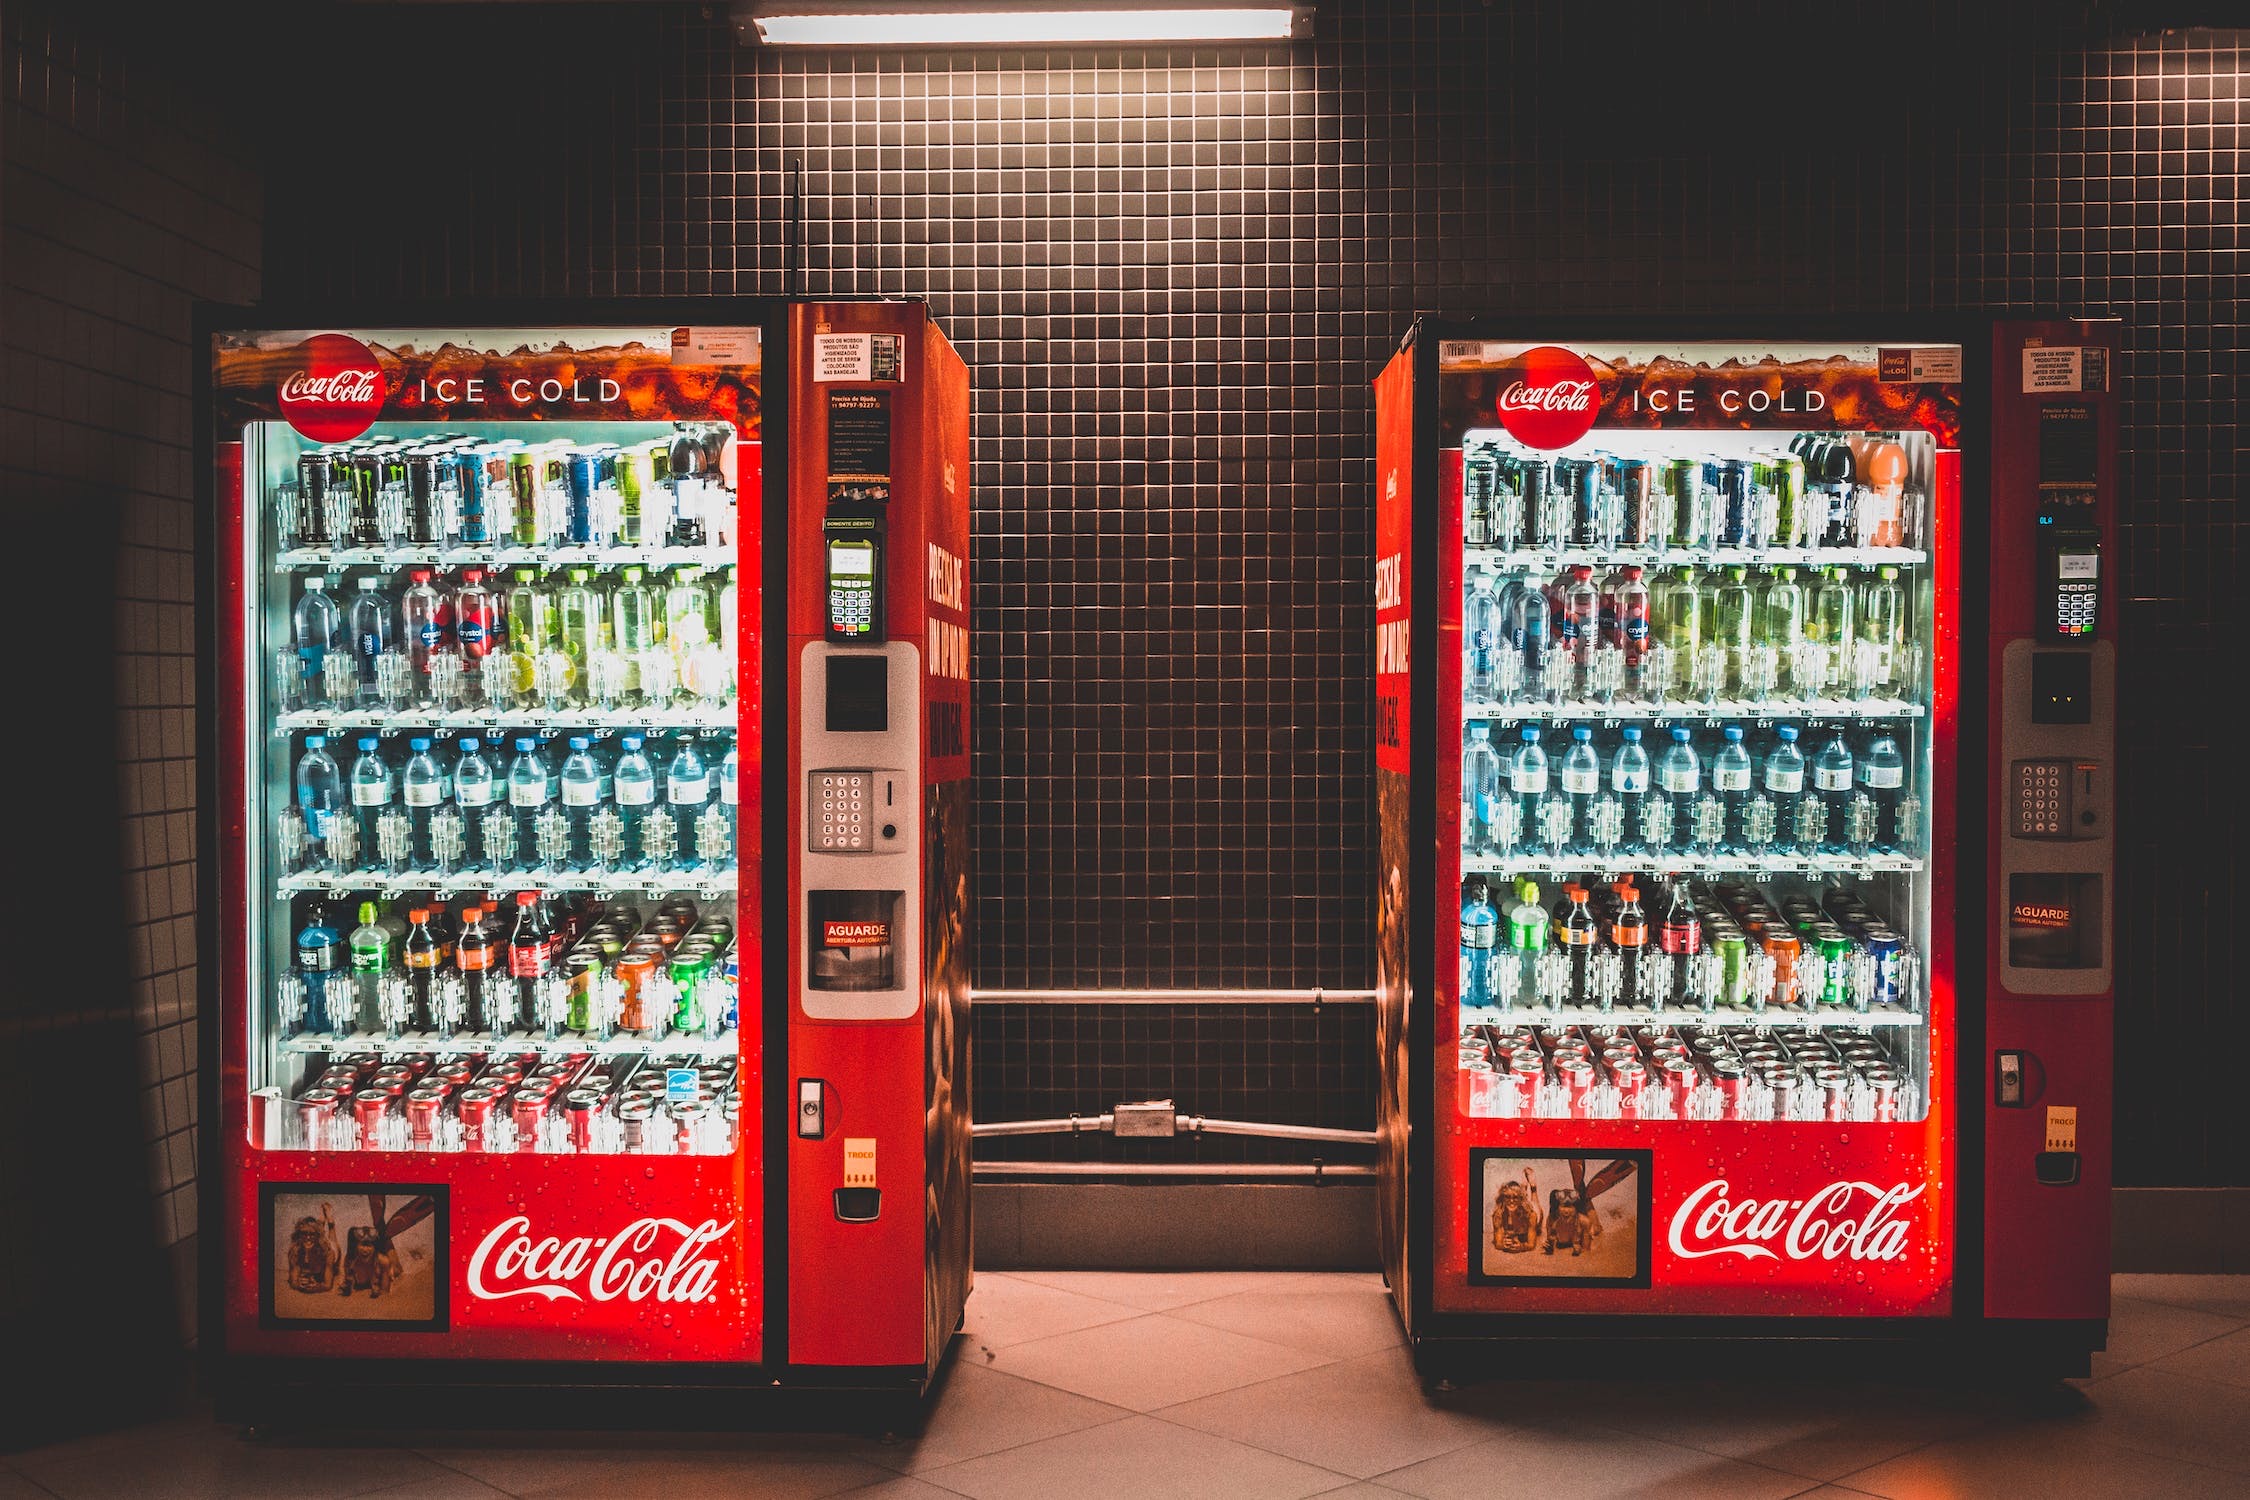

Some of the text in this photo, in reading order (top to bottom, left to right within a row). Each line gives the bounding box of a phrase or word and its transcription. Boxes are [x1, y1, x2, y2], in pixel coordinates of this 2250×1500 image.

[281, 369, 377, 403] Coca-Cola
[420, 379, 622, 402] ICE COLD
[1500, 380, 1596, 412] Coca-Cola
[1634, 390, 1826, 412] ICE COLD
[2014, 905, 2070, 920] AGUARDE
[848, 1151, 874, 1159] TROCO
[1668, 1179, 1926, 1261] Coca-Cola
[467, 1215, 735, 1303] Coca-Cola
